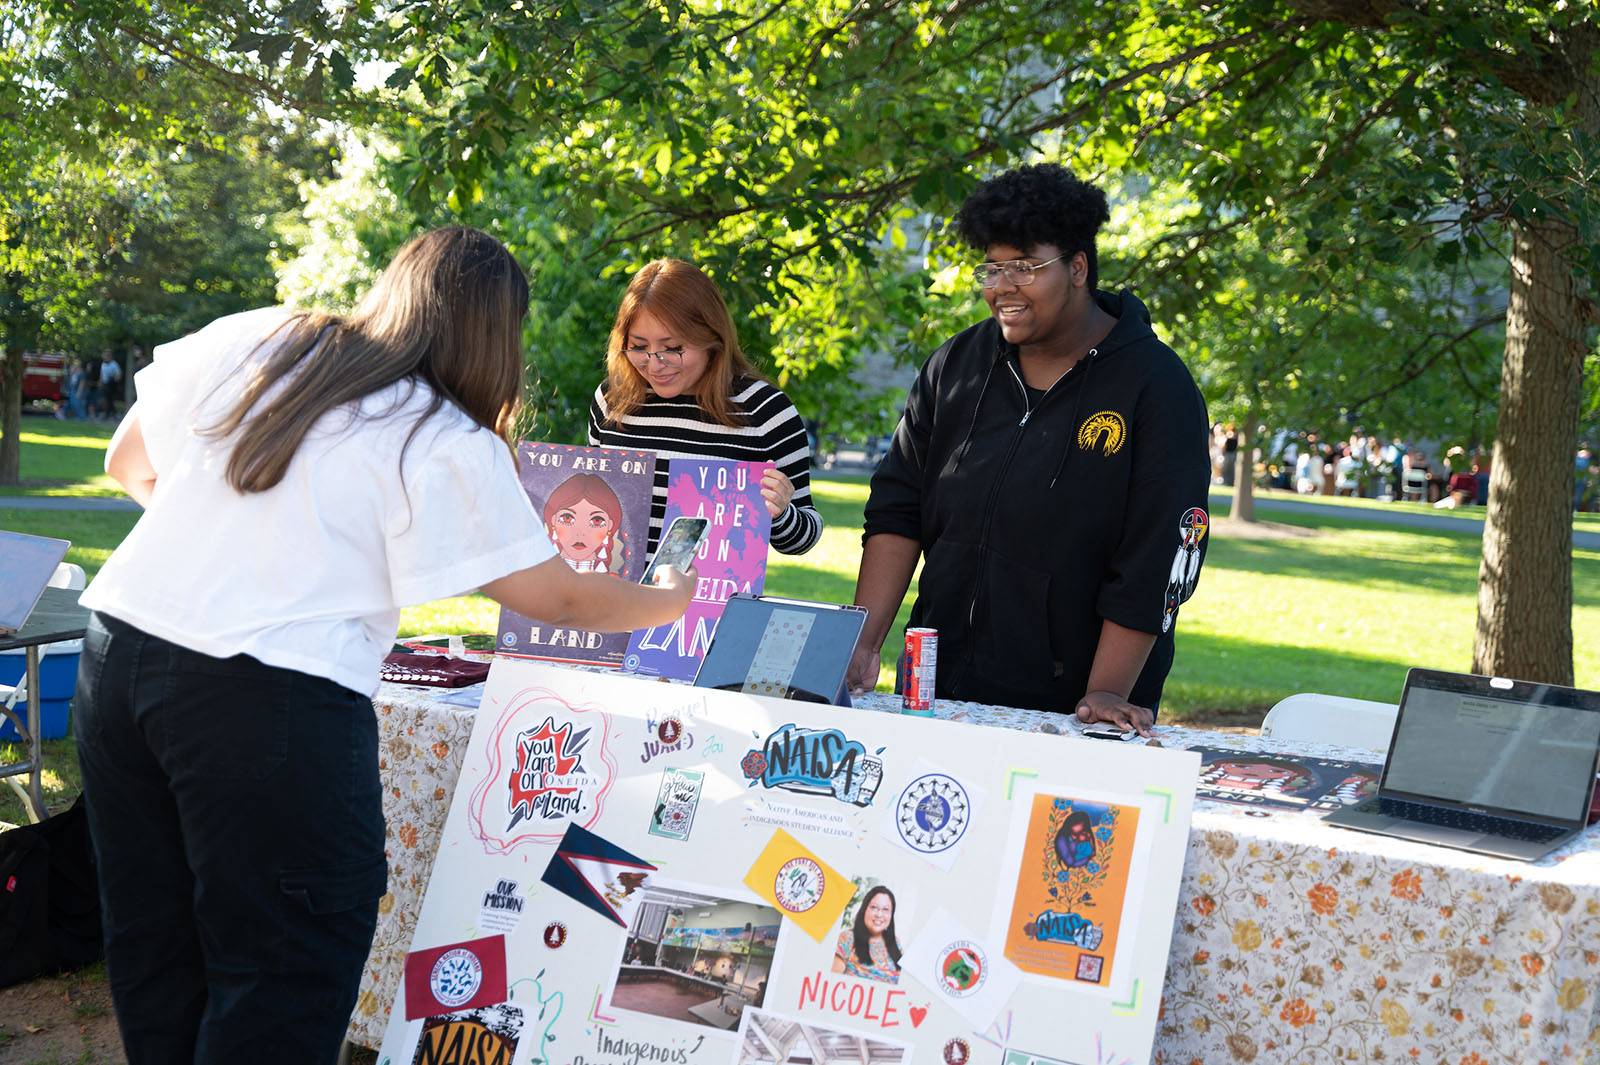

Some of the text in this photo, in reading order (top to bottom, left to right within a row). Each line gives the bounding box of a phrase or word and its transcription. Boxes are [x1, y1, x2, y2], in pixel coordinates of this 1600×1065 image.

[527, 452, 647, 475] YOU ARE ON
[699, 466, 747, 491] YOU
[696, 502, 744, 527] ARE
[698, 538, 730, 562] ON
[693, 576, 752, 602] EIDA
[530, 626, 603, 649] LAND
[638, 614, 721, 658] LAN
[532, 756, 555, 773] are
[522, 773, 597, 789] on ONEIDA
[790, 821, 820, 833] STUDENT
[497, 880, 517, 896] OUR
[484, 893, 523, 913] MISSION
[798, 971, 906, 1027] NICOLE
[597, 1028, 687, 1065] Indigenous
